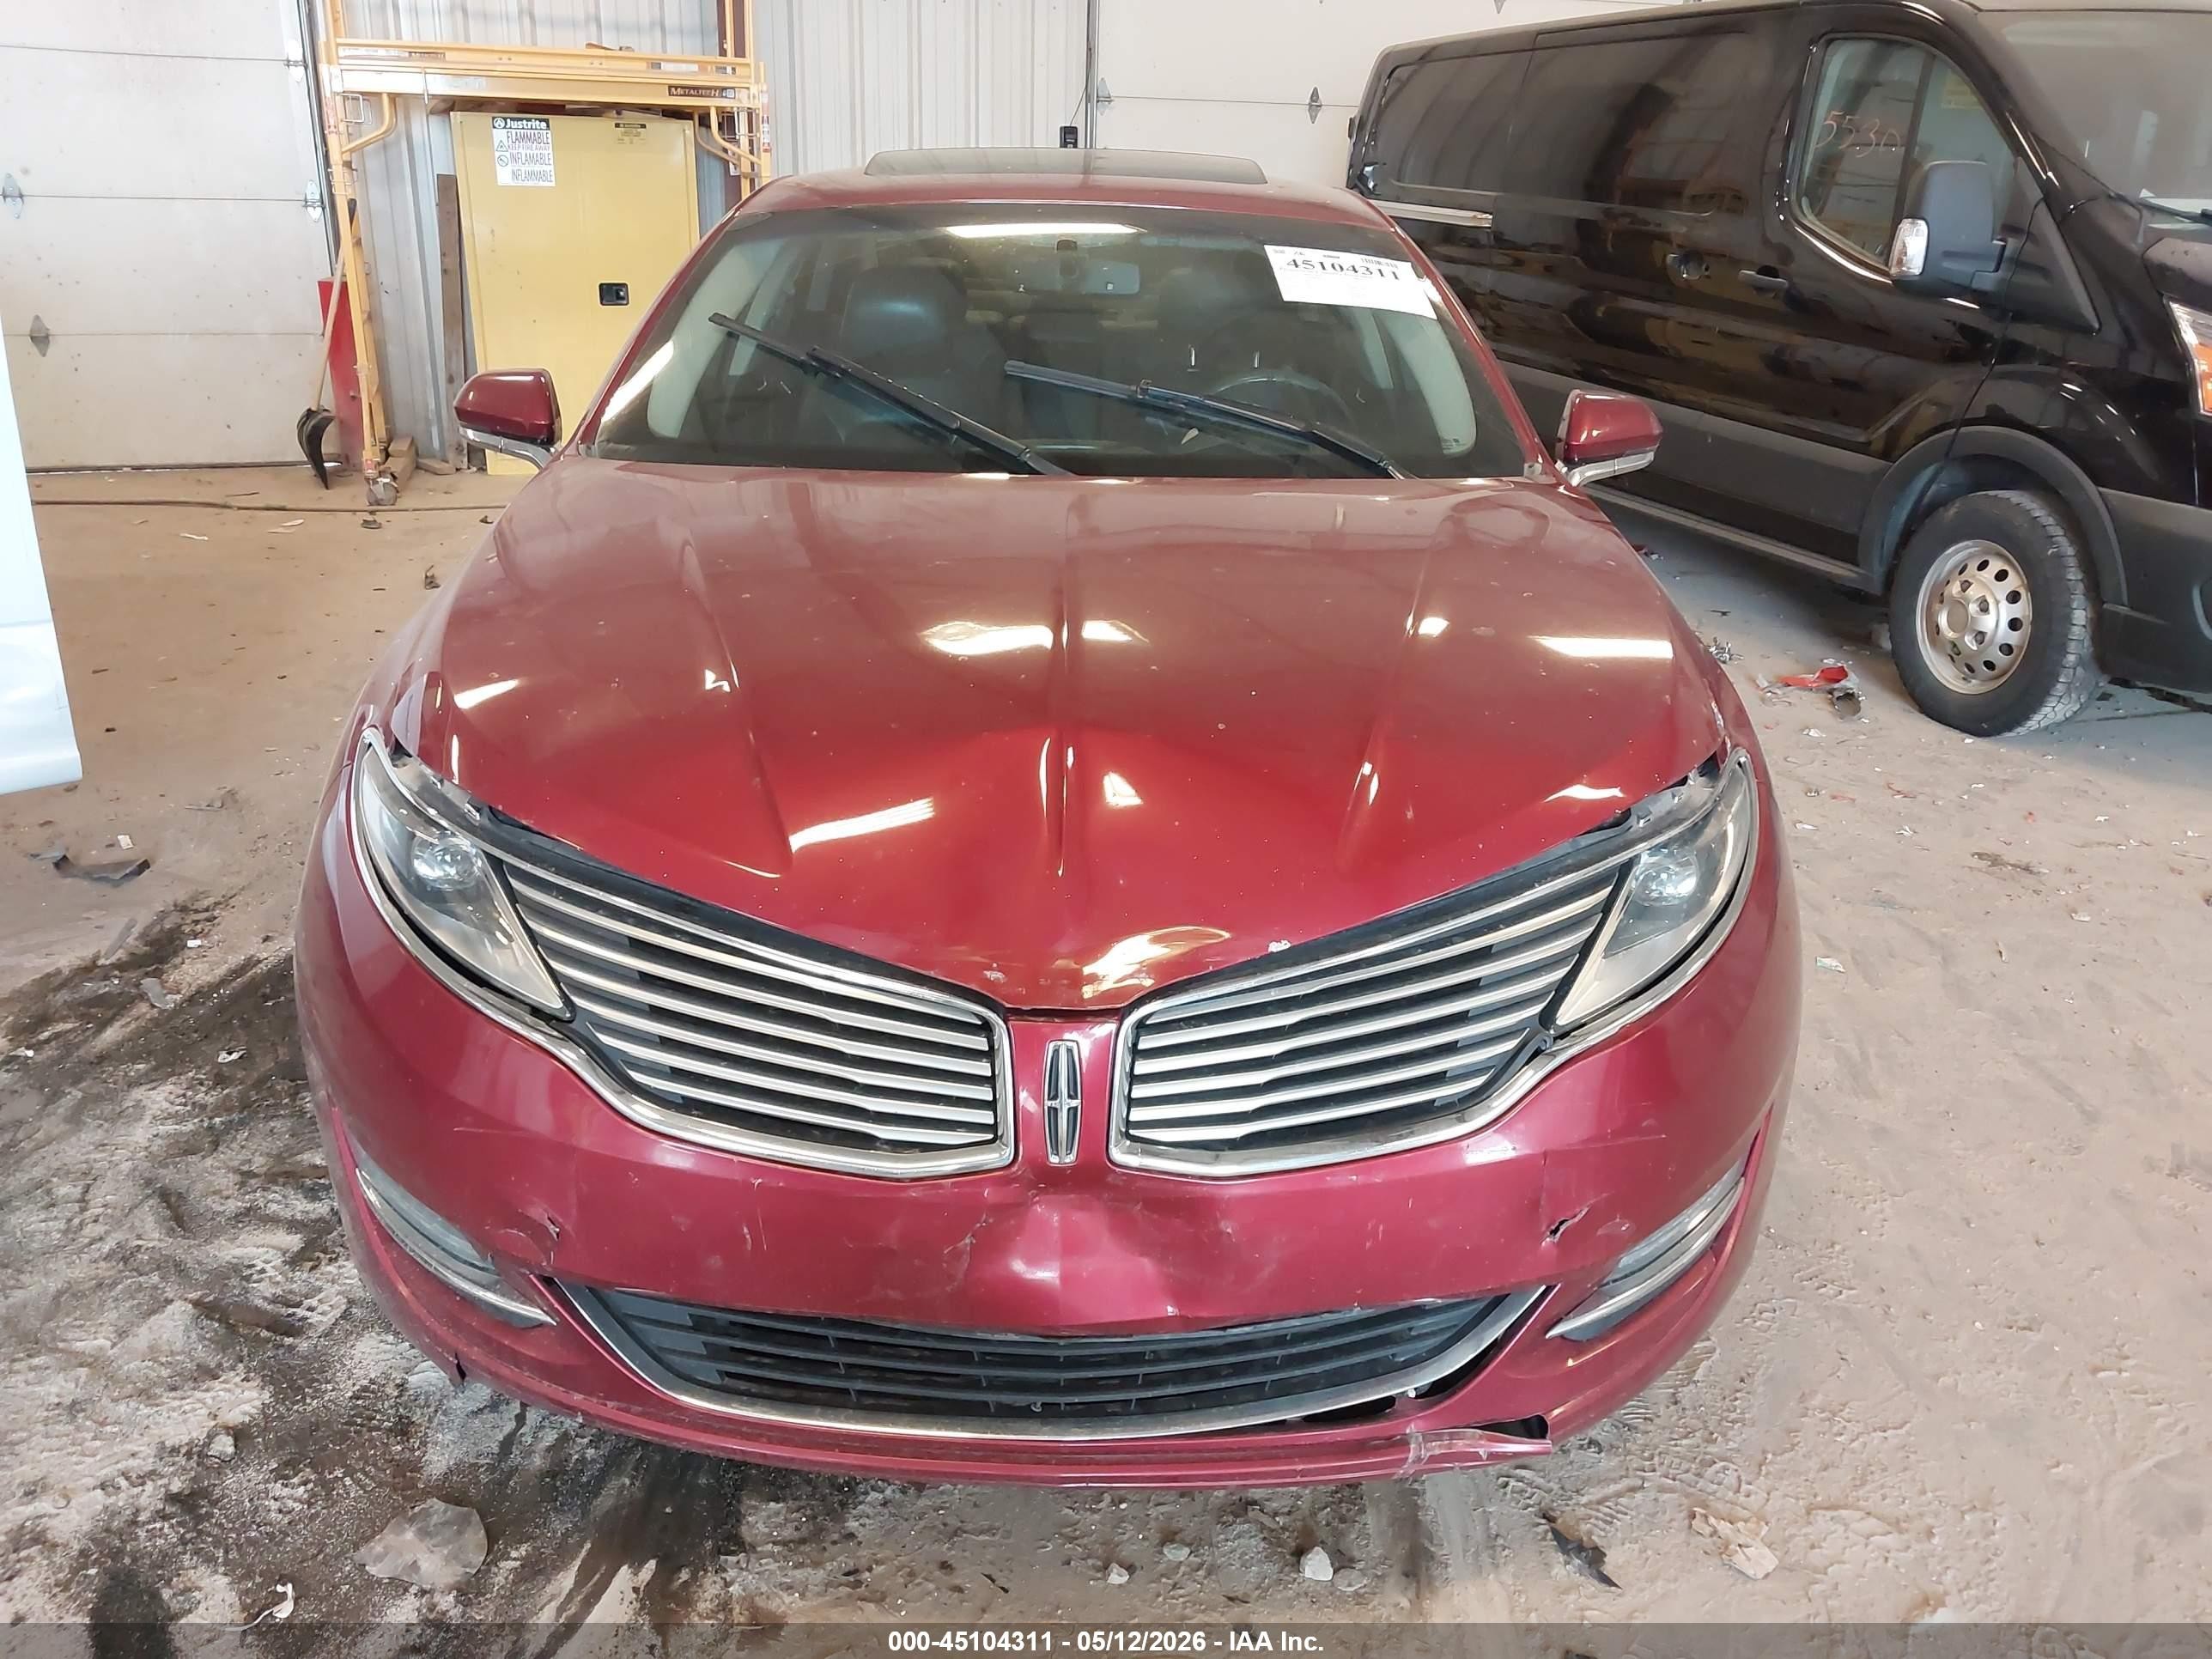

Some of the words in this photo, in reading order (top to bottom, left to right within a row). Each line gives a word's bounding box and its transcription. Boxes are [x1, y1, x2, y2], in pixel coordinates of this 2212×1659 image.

[506, 118, 548, 129] Justrite
[507, 131, 550, 144] FLAMMABLE
[509, 152, 552, 165] INFLAMABLE
[511, 168, 554, 182] INFLAMMABLE
[1286, 258, 1401, 281] 45104311
